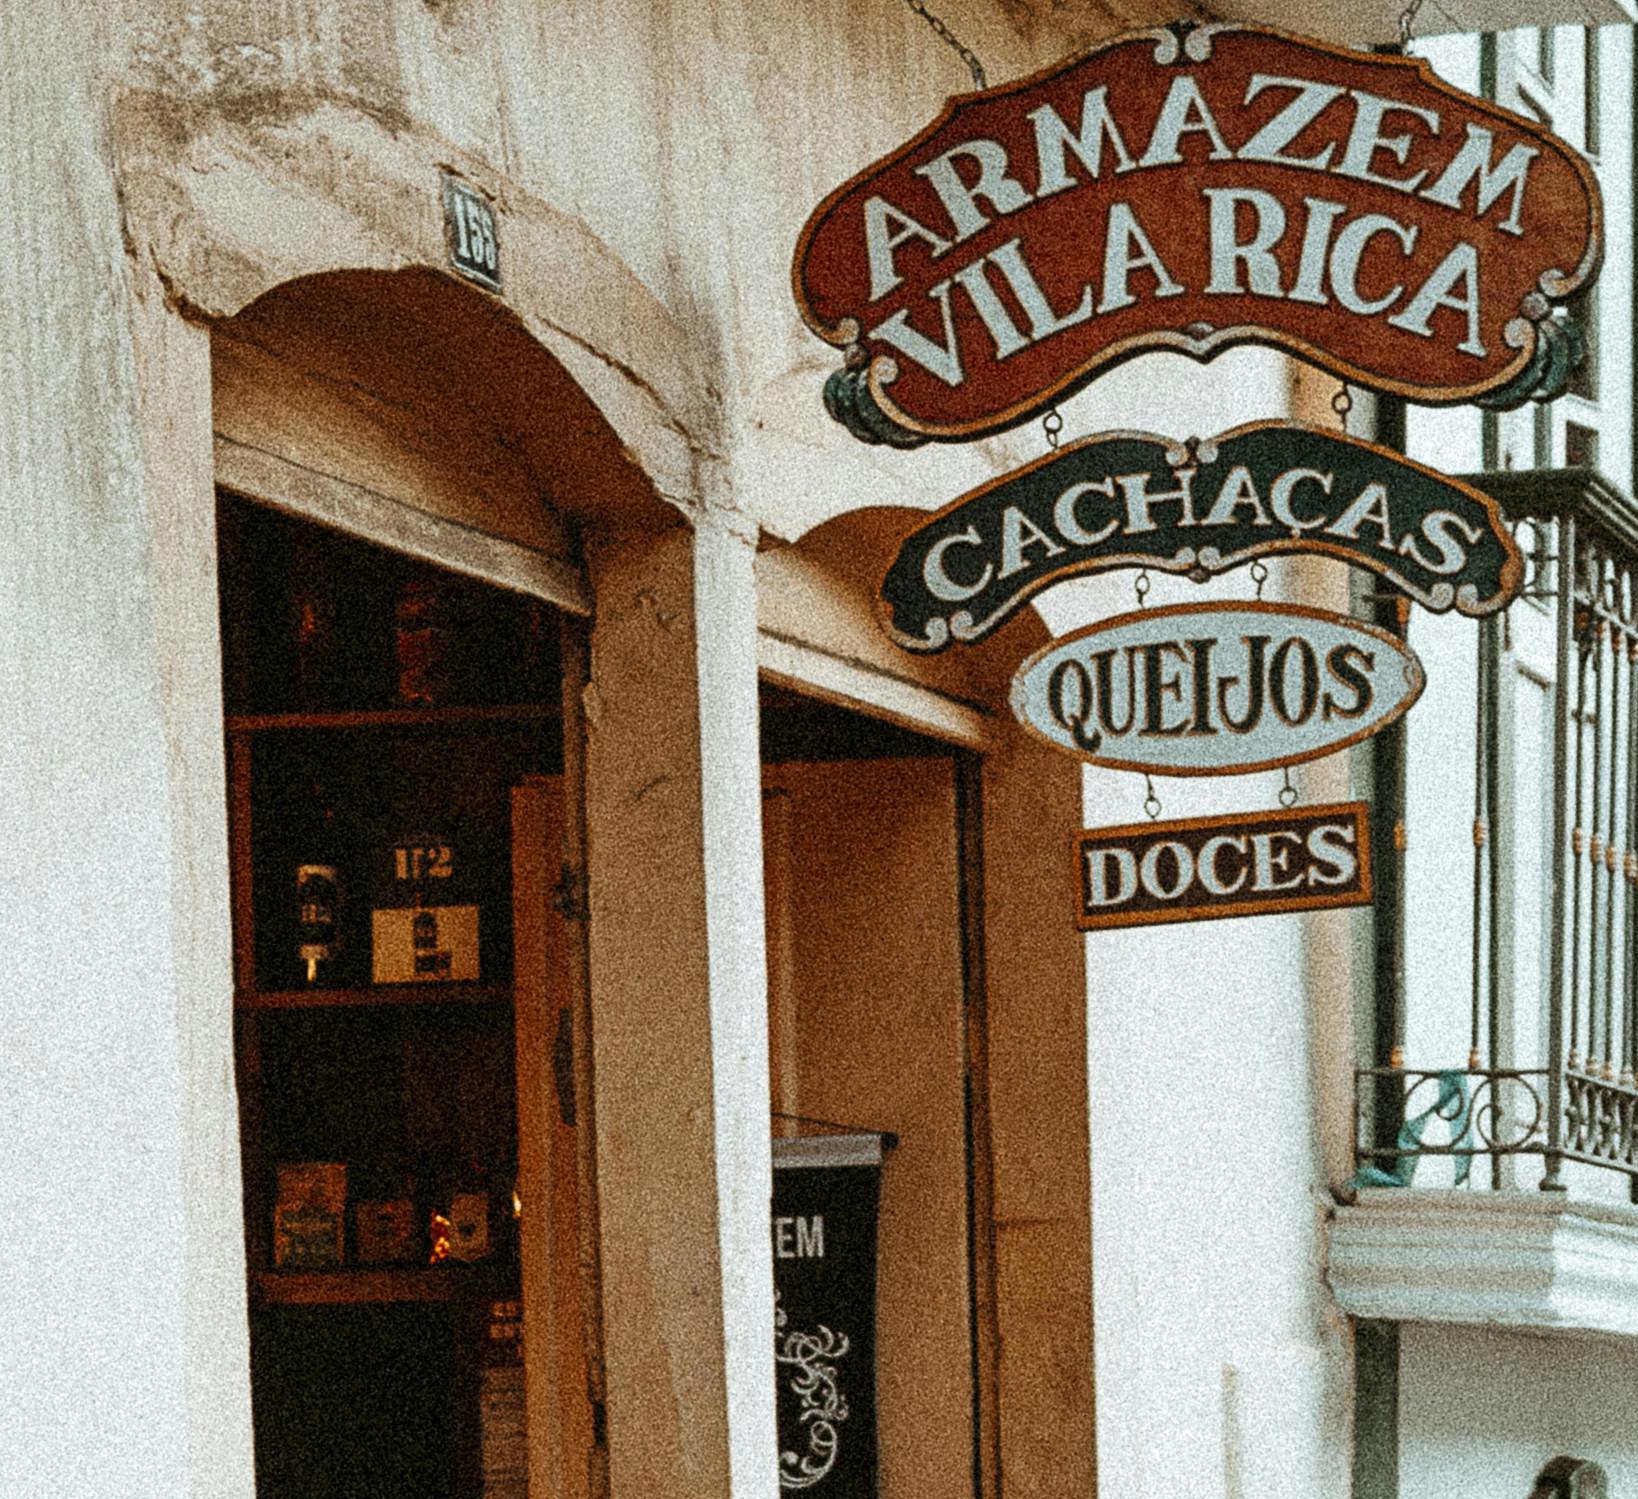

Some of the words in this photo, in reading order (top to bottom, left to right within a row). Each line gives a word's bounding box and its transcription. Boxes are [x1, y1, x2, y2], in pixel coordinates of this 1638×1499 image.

[862, 74, 1541, 300] ARMAZEM
[868, 202, 1185, 389] VILA
[1202, 187, 1486, 357] RICA
[923, 465, 1484, 601] CACHAÇAS
[1046, 634, 1378, 753] QUEIJOS
[1085, 822, 1357, 908] DOCES
[776, 1215, 824, 1258] EM
